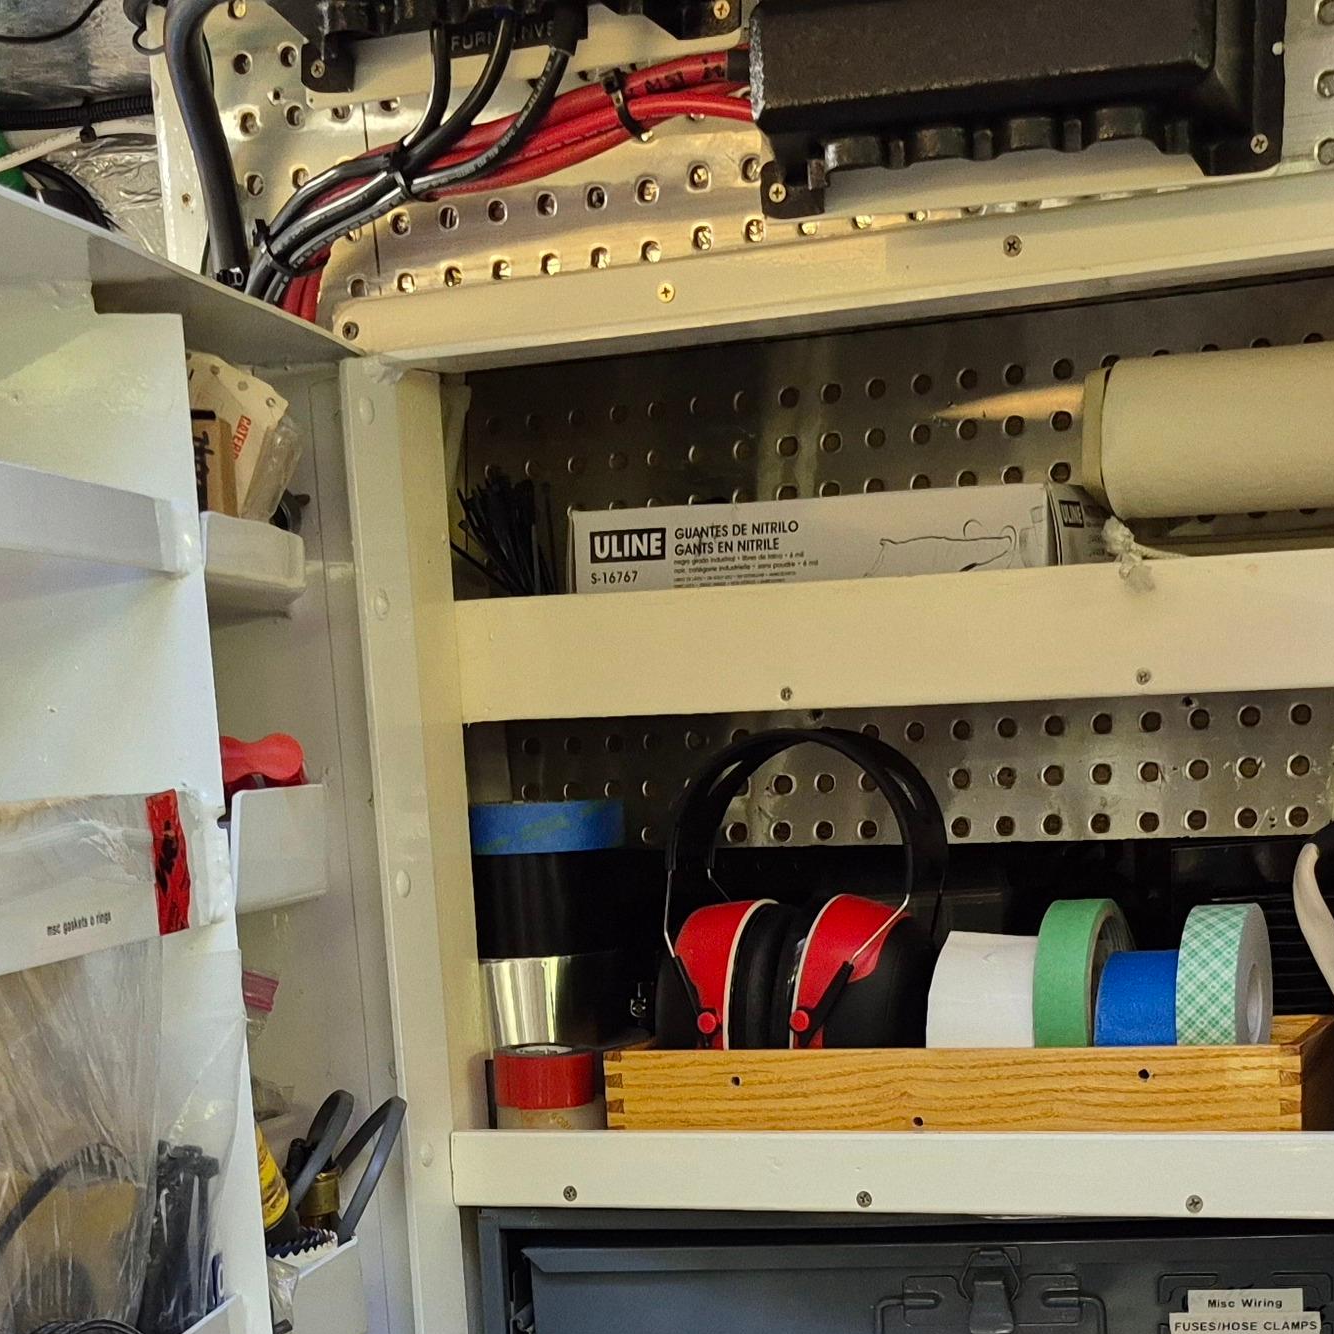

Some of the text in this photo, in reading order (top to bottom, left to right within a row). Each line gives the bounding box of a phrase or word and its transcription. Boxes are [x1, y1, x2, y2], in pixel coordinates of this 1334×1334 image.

[674, 520, 799, 540] GUANTES DE NITRILO
[593, 532, 662, 559] ULINE
[674, 537, 780, 556] GANTS EN NITRILE
[591, 571, 638, 585] S-16767
[1207, 1299, 1283, 1309] Misc Wiring
[1174, 1321, 1317, 1331] FUSES/HOSE CLAMPS
